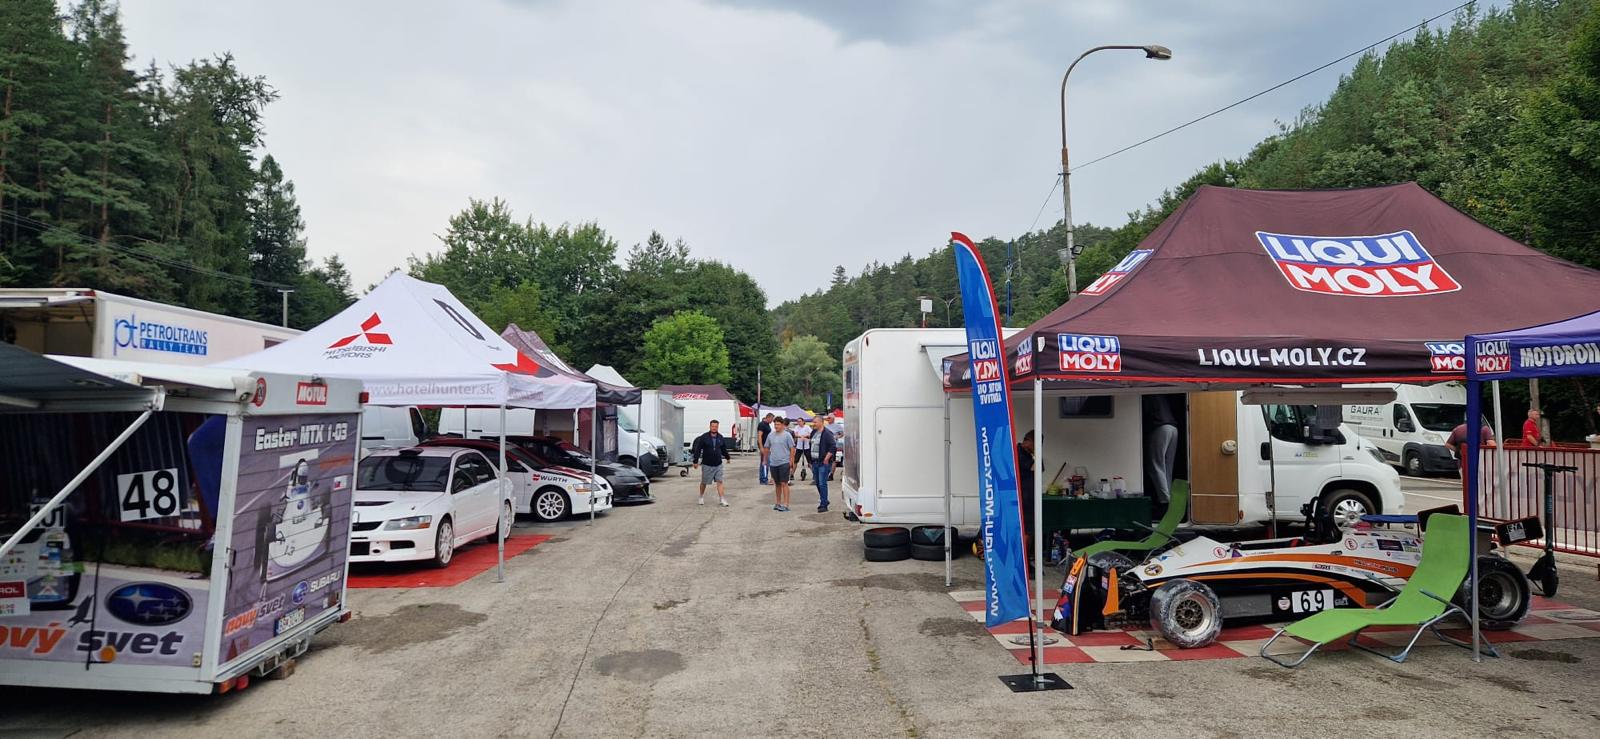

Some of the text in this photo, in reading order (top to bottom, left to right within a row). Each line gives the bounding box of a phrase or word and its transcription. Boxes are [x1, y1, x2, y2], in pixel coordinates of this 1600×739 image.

[1267, 234, 1421, 265] LIQUI
[1285, 263, 1441, 294] MOLY
[140, 322, 208, 345] PETROLTRANS
[140, 338, 206, 355] RALLY TEAM
[322, 345, 387, 355] MITSUBISHI
[1061, 335, 1117, 353] LIQUI
[1429, 344, 1465, 355] LIQ
[1476, 341, 1509, 356] LIQUI
[326, 352, 373, 360] MOTORS
[1063, 353, 1119, 370] MOLY
[1197, 348, 1366, 367] LIQUI-MOLY.CZ
[1435, 356, 1465, 370] MO
[1477, 356, 1510, 373] MOLY
[298, 385, 326, 402] MOTUL
[1350, 405, 1380, 416] GAURA
[255, 426, 298, 451] Easter
[299, 424, 325, 446] MTX
[122, 469, 177, 519] 48
[310, 571, 341, 593] SUBARU
[1300, 590, 1325, 613] 69
[76, 630, 184, 656] svet
